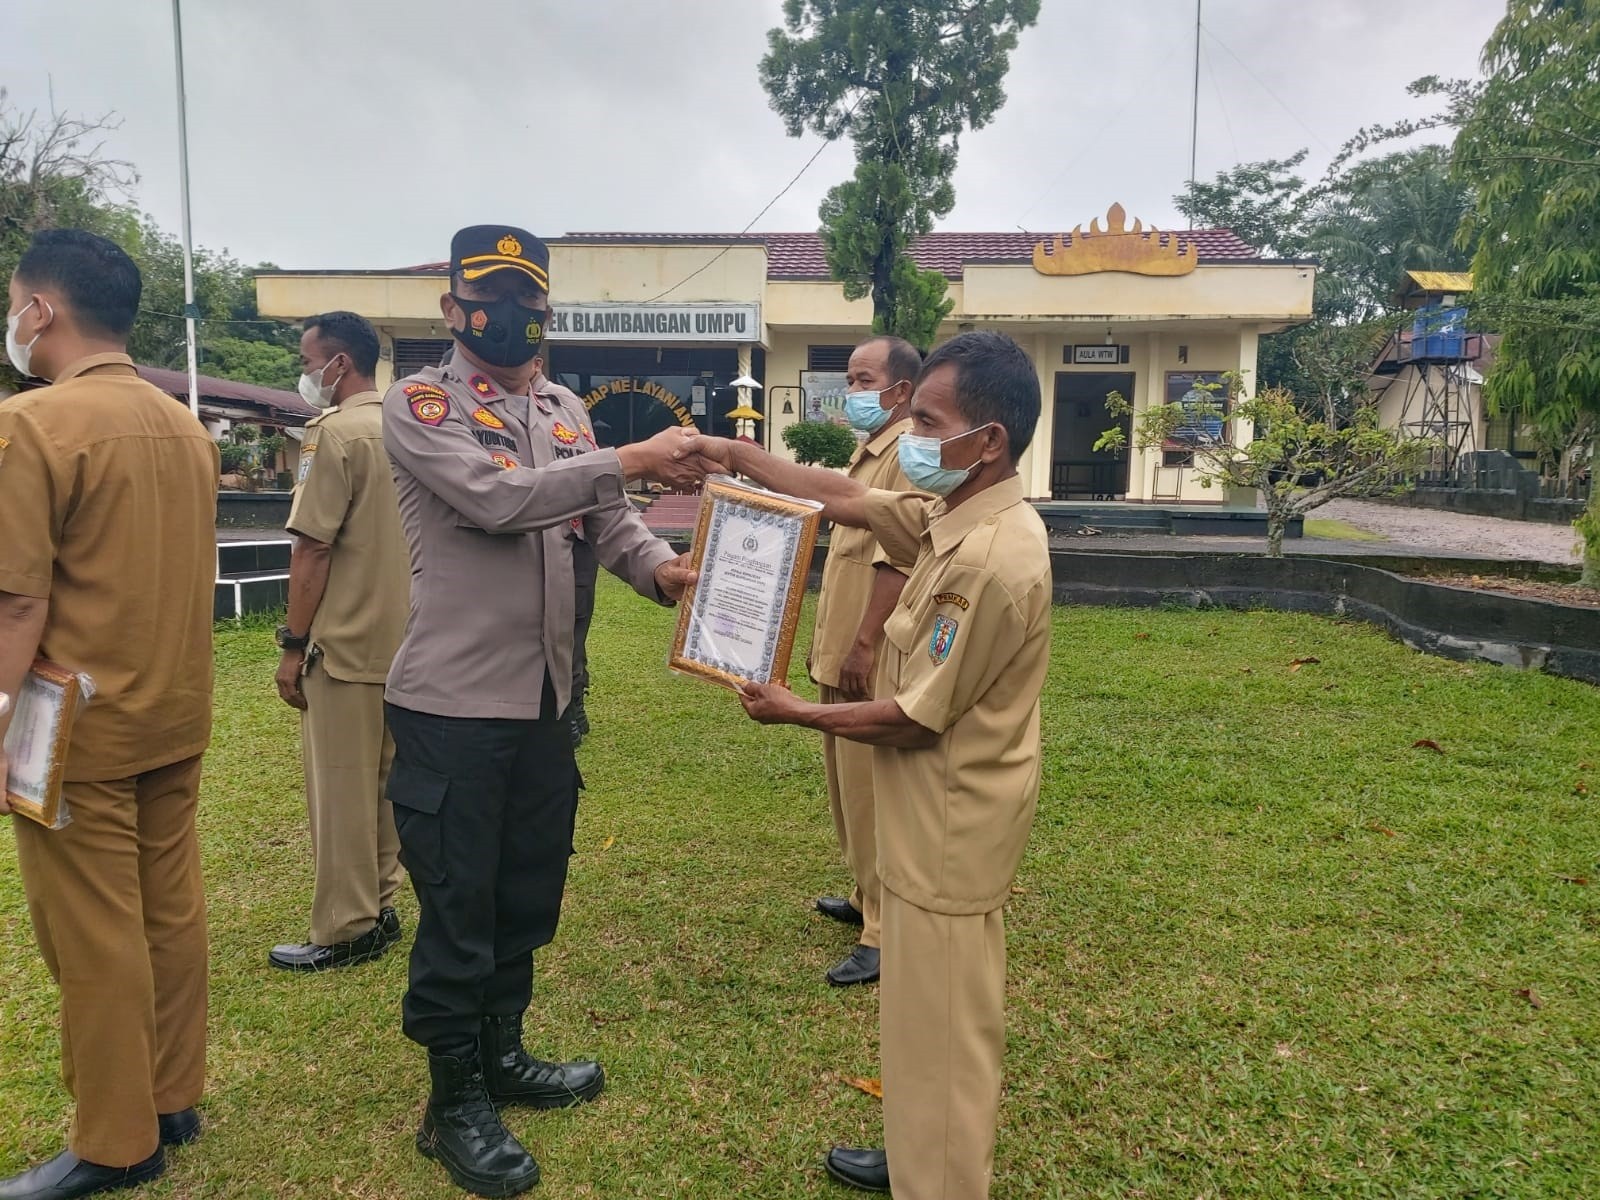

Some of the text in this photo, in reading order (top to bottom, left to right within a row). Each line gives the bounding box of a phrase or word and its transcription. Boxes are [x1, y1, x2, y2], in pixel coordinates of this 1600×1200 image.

[573, 313, 690, 333] BLAMBANGAN
[695, 313, 746, 334] UMPU
[1080, 350, 1096, 359] AULA
[584, 384, 609, 410] SIAP
